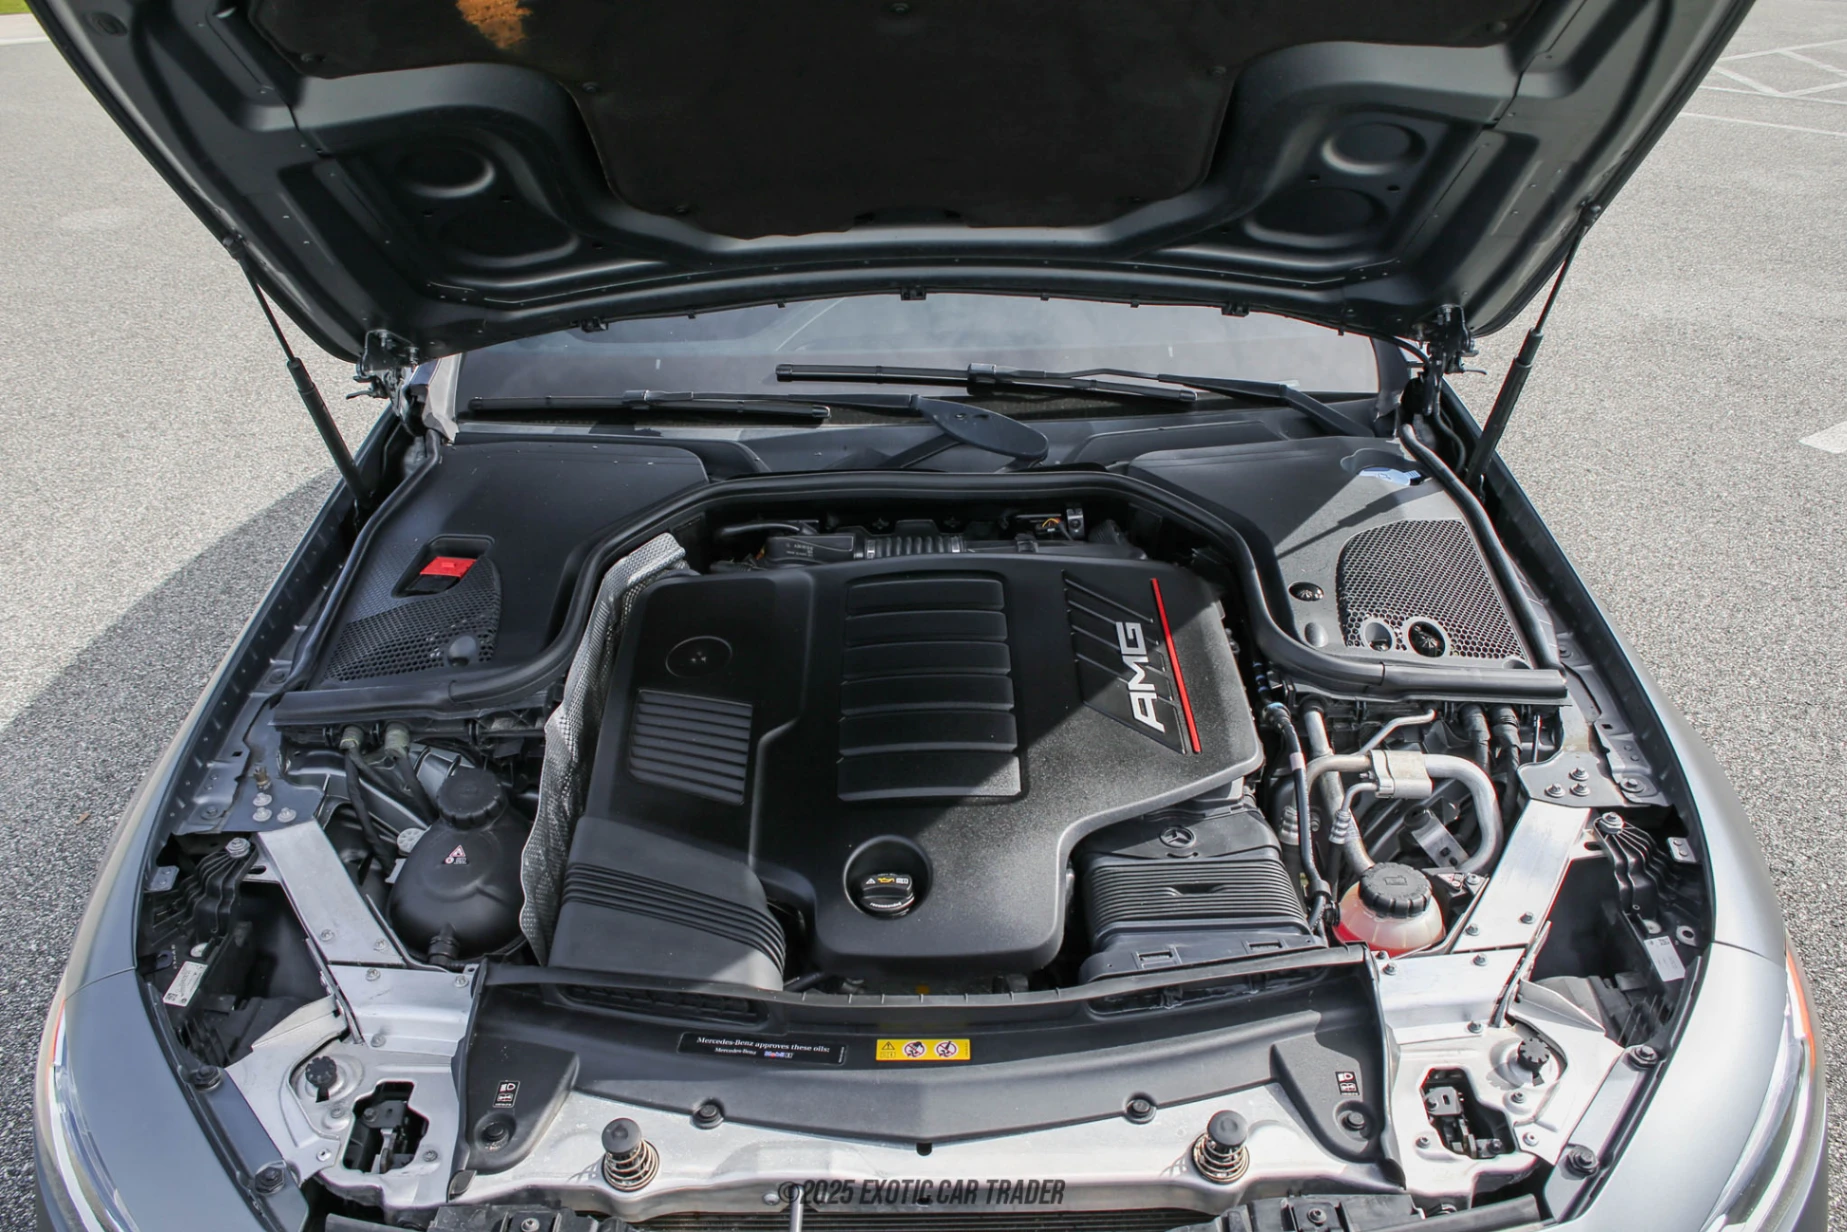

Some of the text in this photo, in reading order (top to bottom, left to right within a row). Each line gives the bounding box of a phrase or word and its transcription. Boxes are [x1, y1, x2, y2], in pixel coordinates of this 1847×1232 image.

[1116, 621, 1165, 733] AMG
[696, 1036, 754, 1047] Mercedes-Benz
[755, 1042, 790, 1050] approves
[791, 1044, 812, 1052] these
